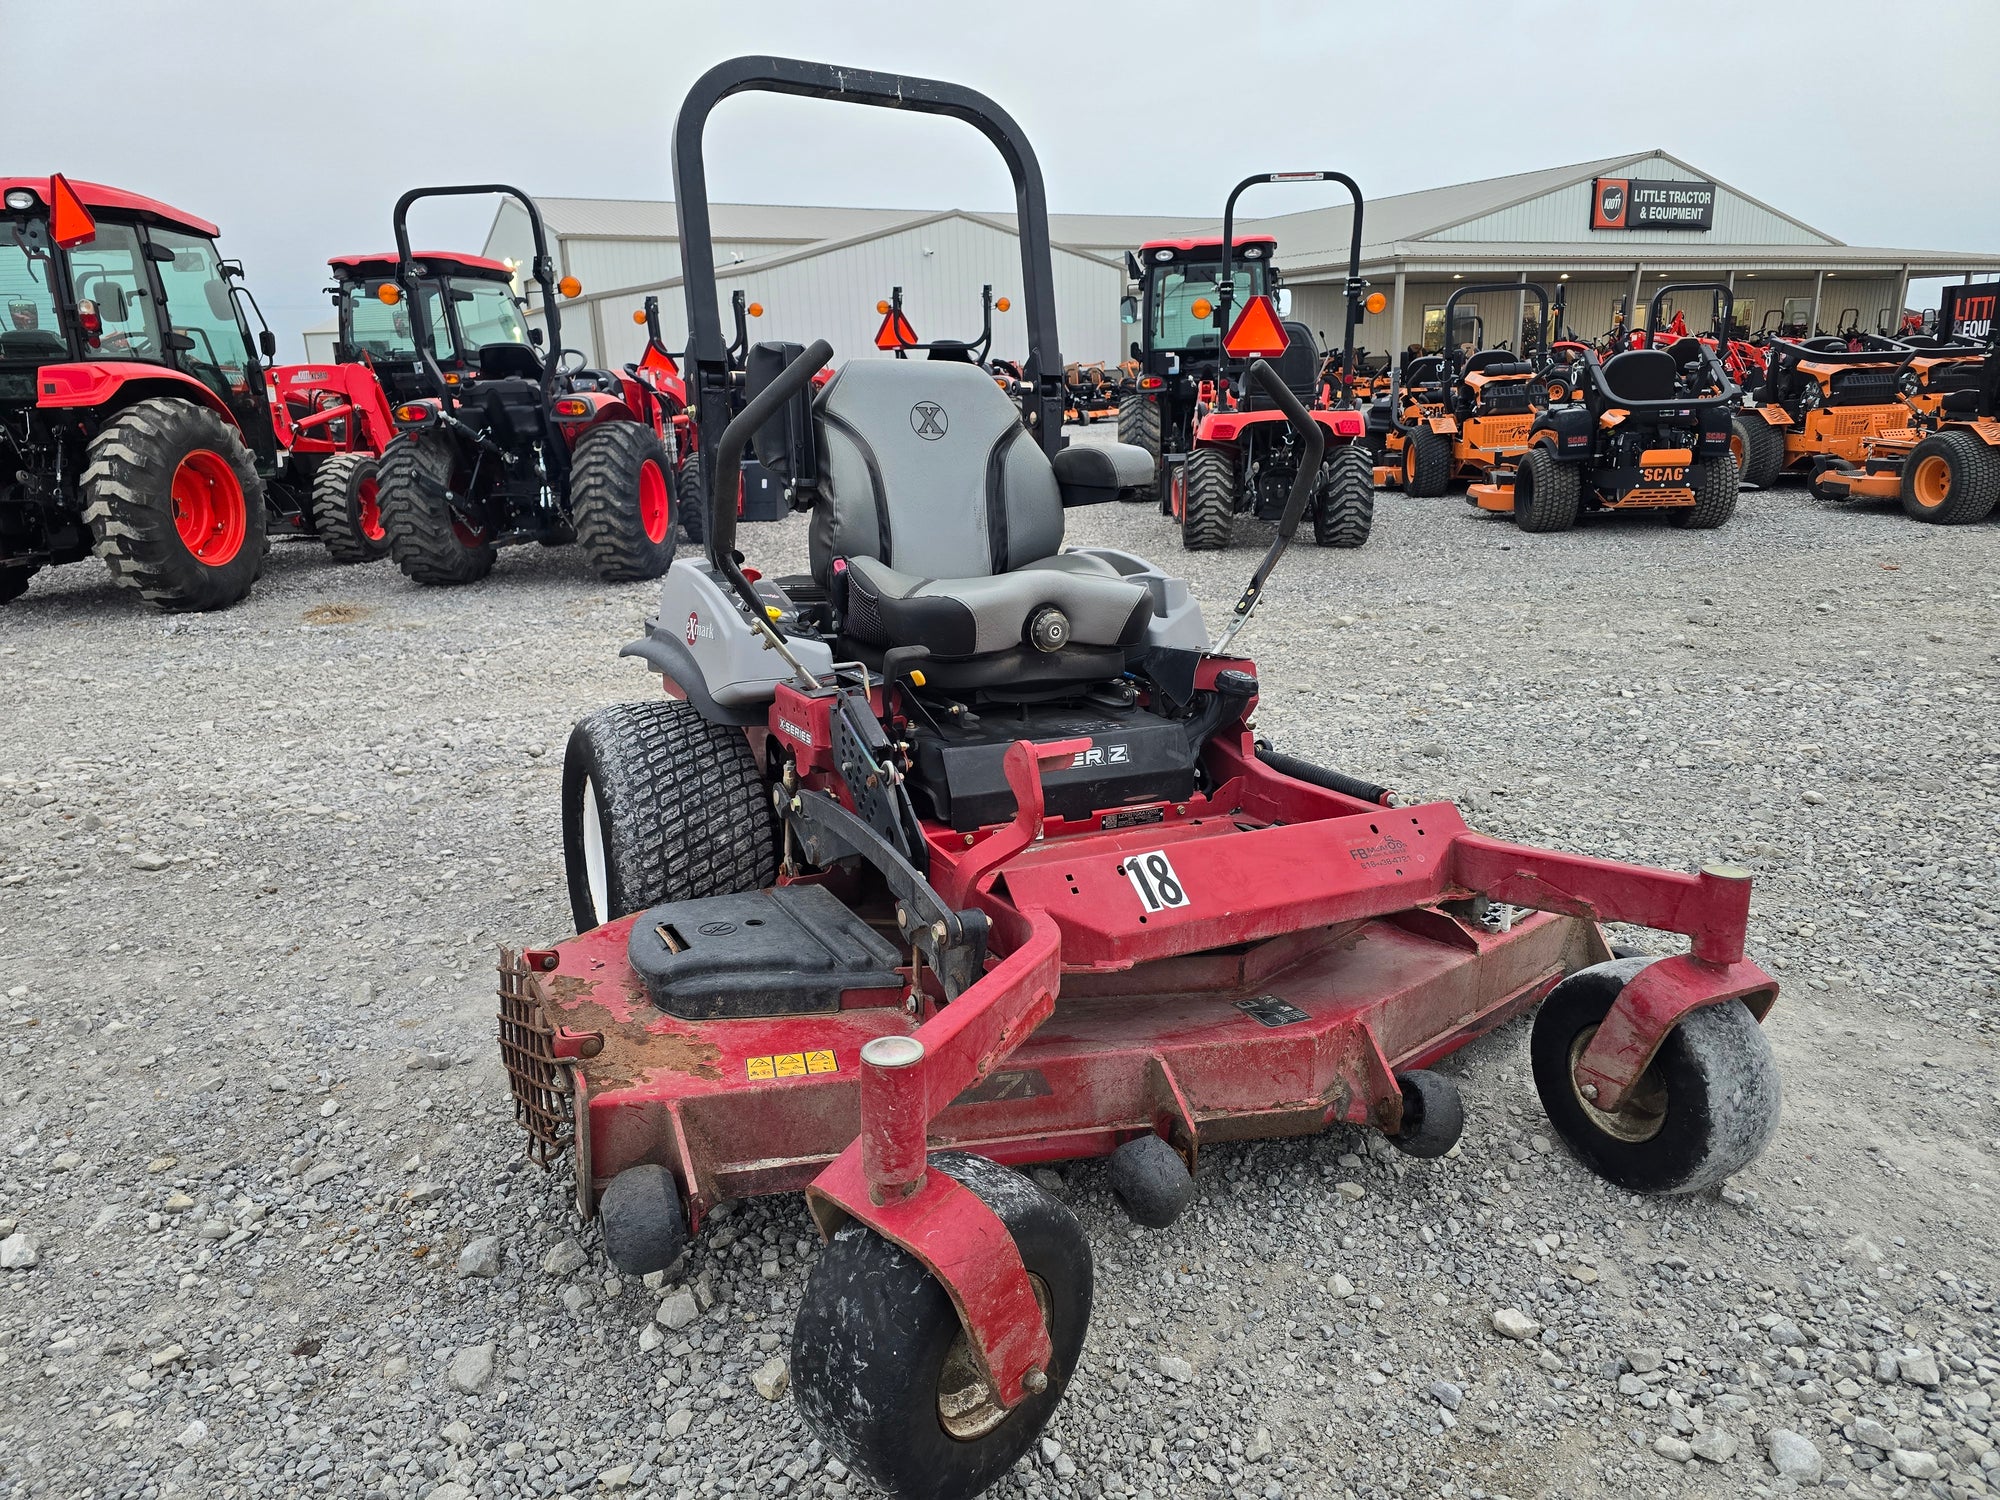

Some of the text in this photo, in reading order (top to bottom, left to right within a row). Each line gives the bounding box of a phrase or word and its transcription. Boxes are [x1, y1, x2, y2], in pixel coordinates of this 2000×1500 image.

[1634, 189, 1711, 205] LITTLE TRACTOR
[1640, 206, 1704, 220] & EQUIPMENT
[1644, 468, 1684, 482] SCAG
[1107, 744, 1129, 764] Z
[1350, 848, 1369, 861] FB
[1126, 854, 1183, 910] 18
